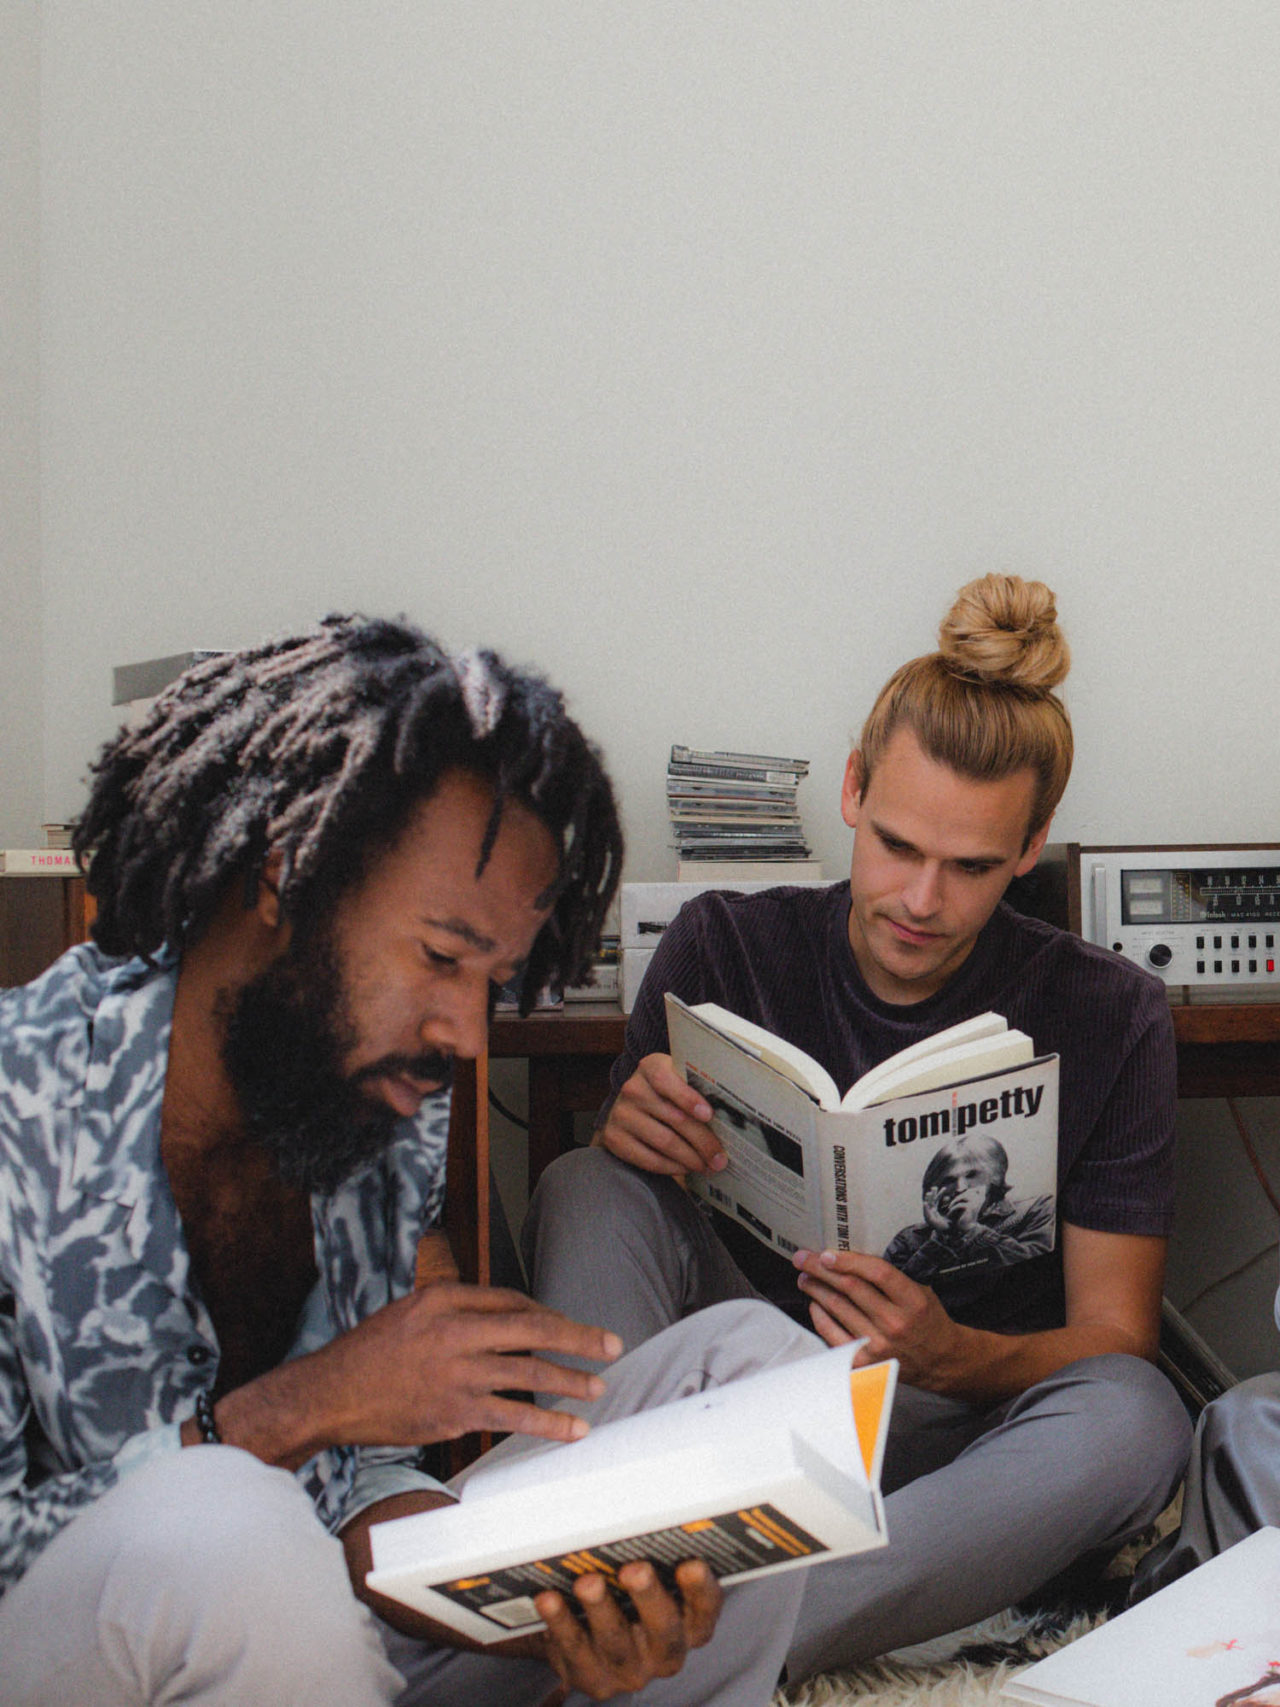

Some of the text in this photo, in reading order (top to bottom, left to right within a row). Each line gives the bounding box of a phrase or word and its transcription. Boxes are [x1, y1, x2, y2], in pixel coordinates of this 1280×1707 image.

[883, 1109, 950, 1147] tom
[957, 1085, 1044, 1135] petty
[833, 1145, 850, 1251] CONVERSATIONS WITH TOM PET
